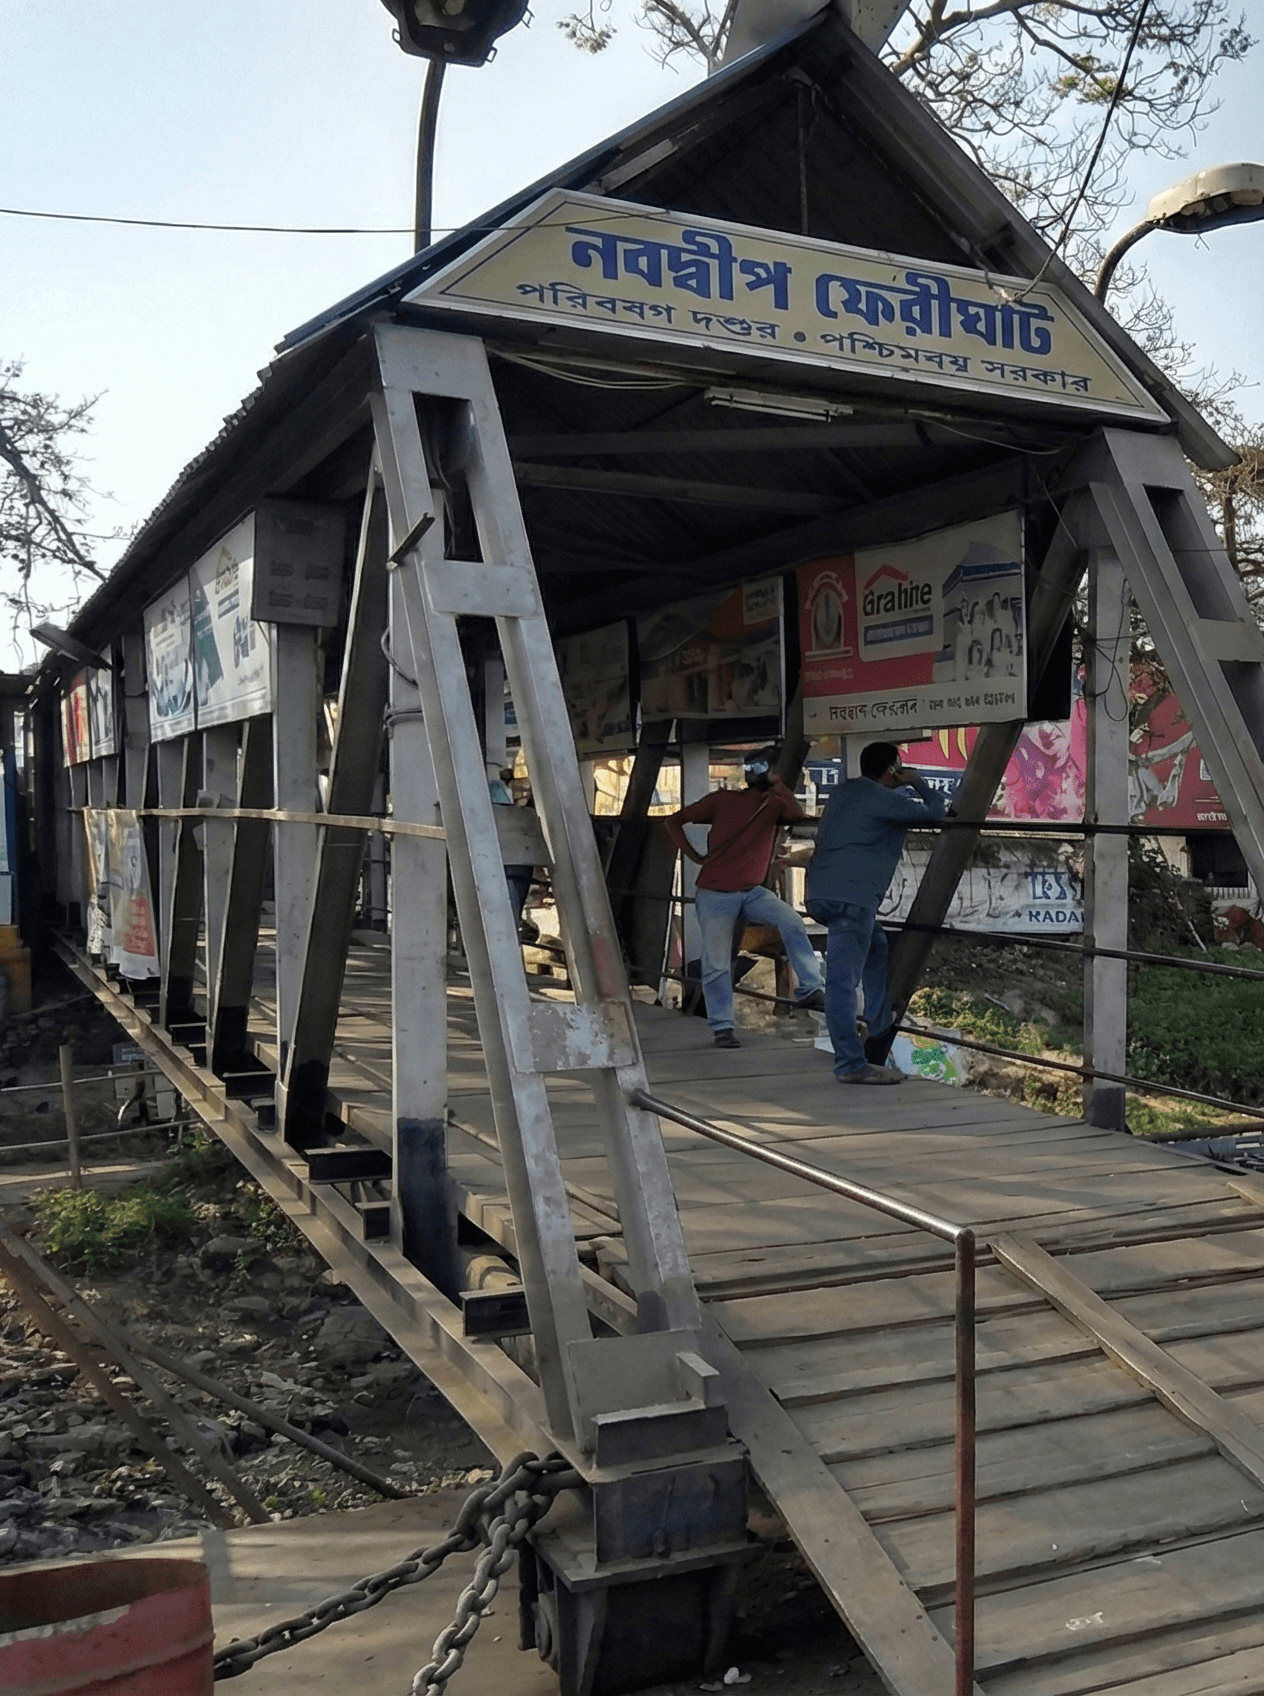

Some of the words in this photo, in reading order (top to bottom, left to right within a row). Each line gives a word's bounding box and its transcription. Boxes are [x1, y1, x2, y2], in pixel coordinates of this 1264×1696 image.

[565, 227, 792, 311] নবদ্বীপ
[815, 271, 1054, 356] ফেরীঘাট
[981, 359, 1092, 393] সরকার
